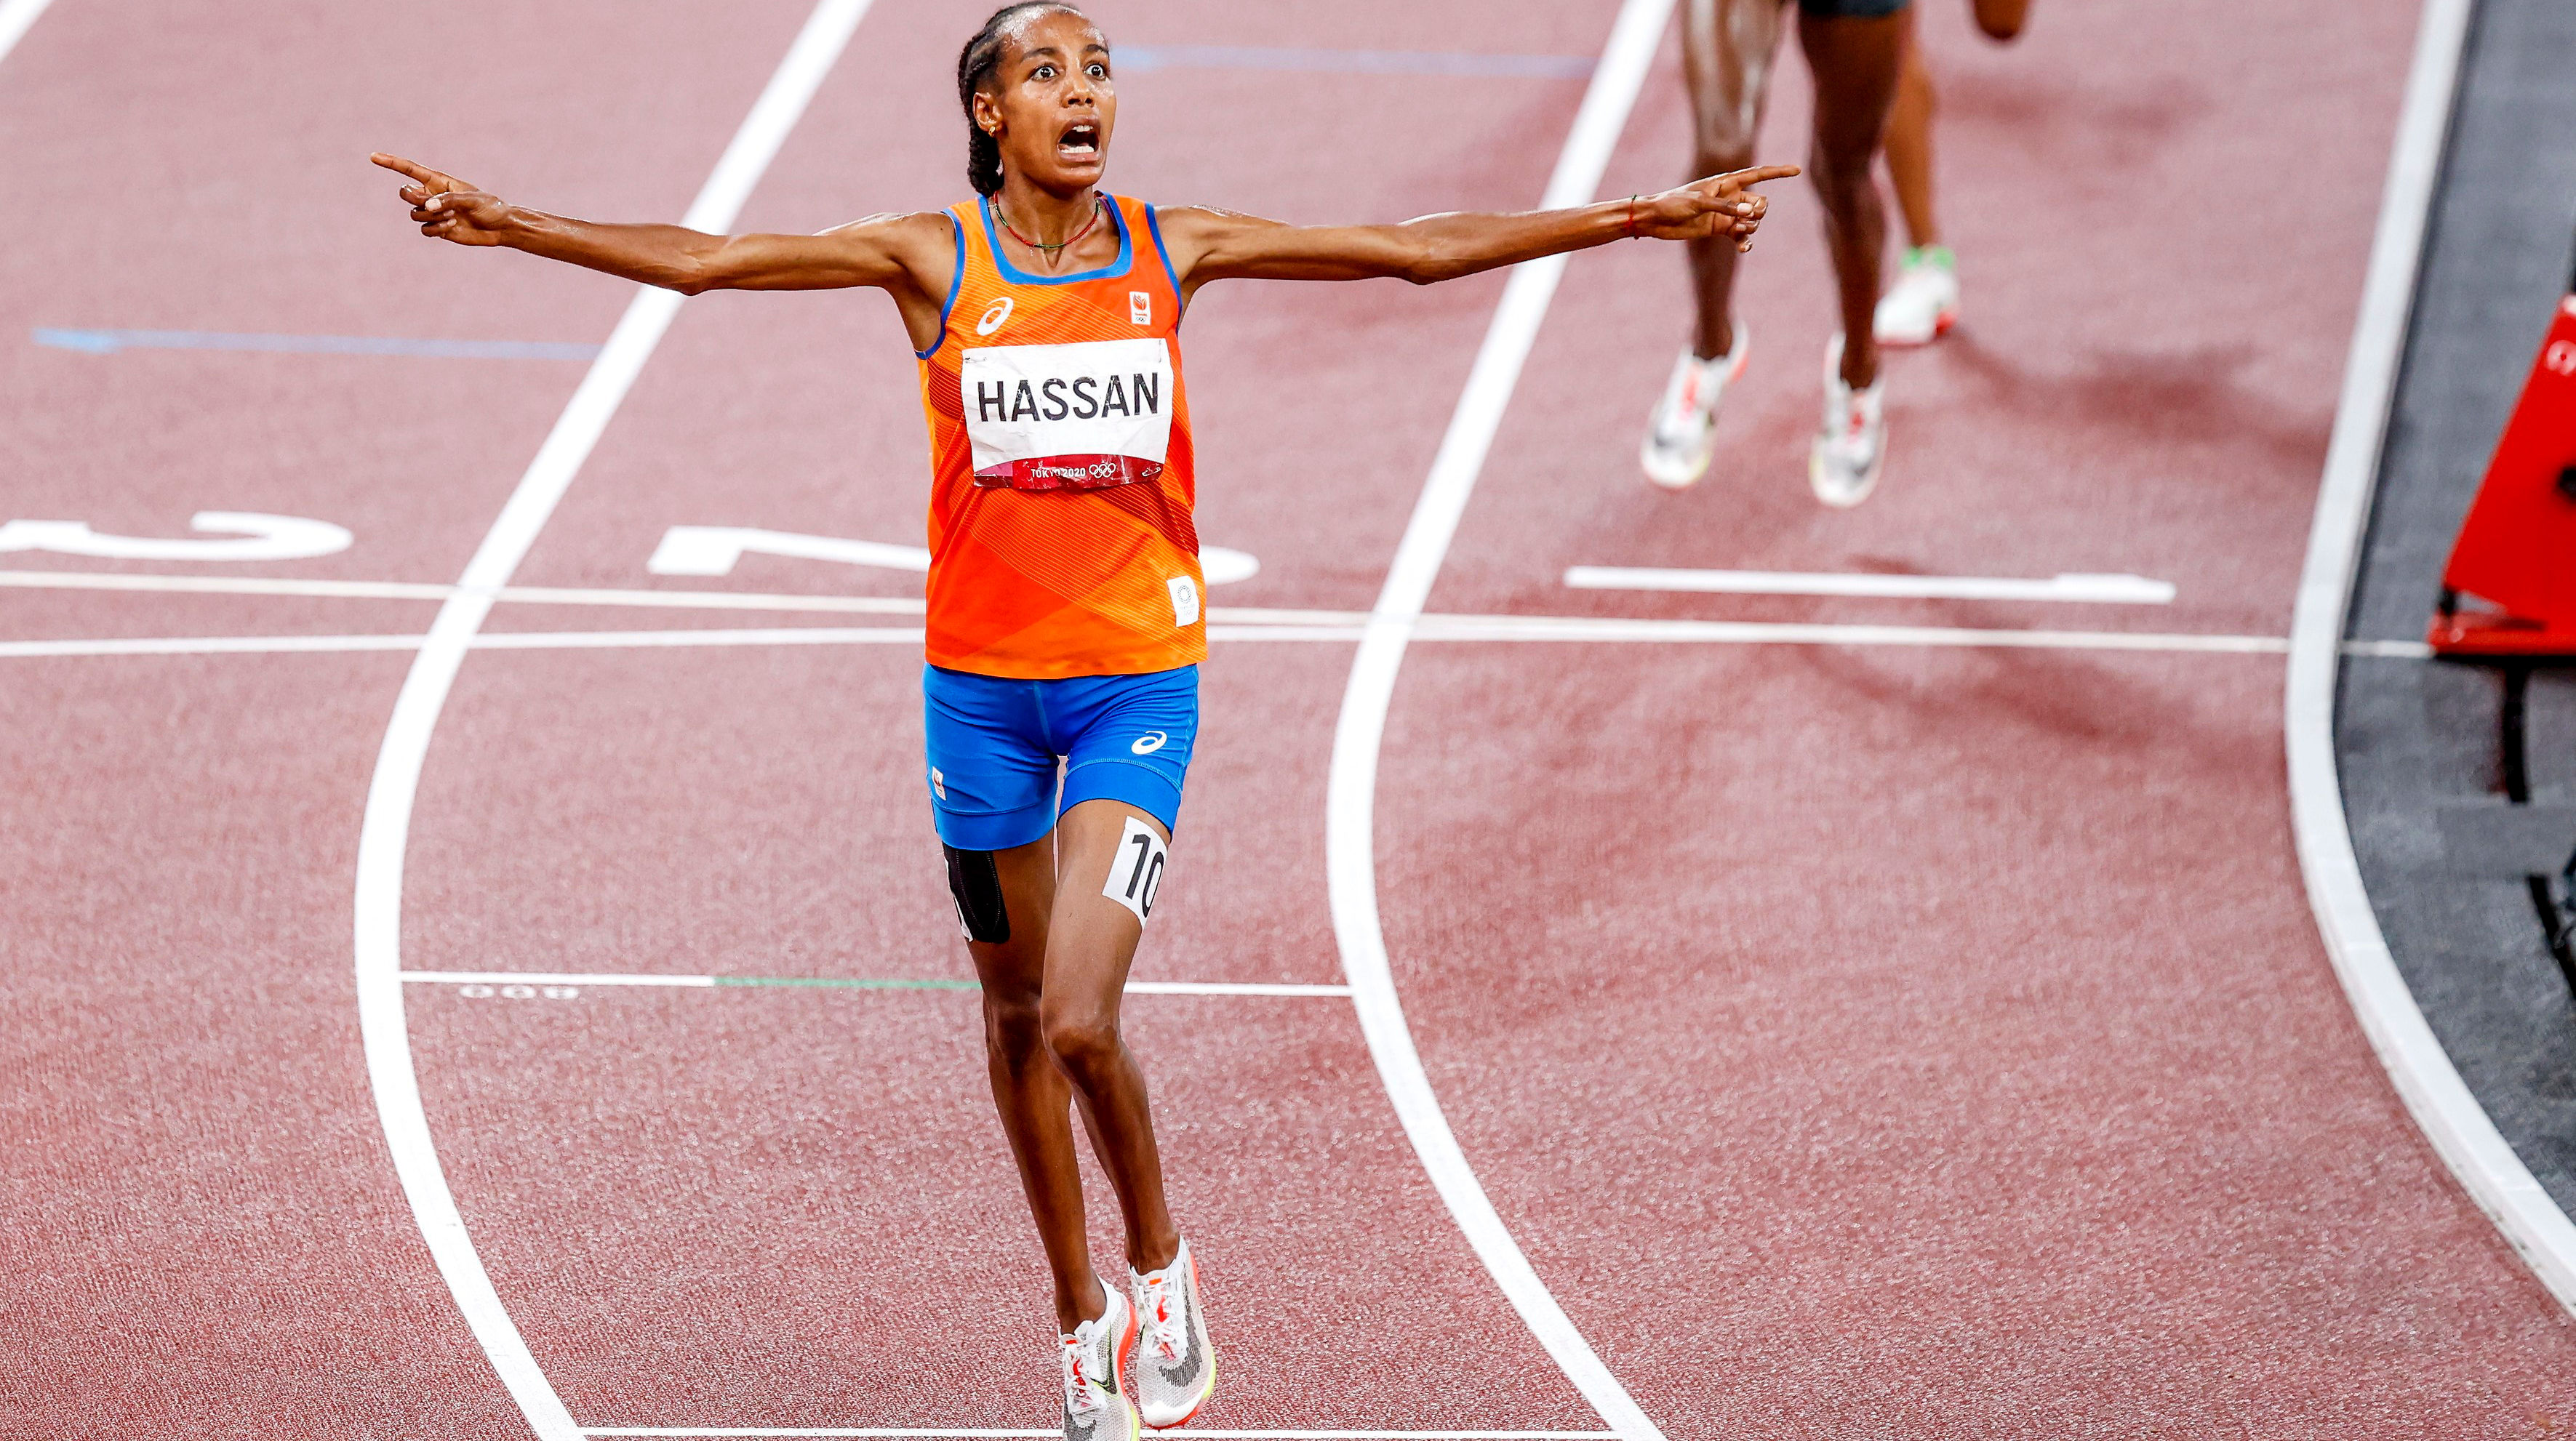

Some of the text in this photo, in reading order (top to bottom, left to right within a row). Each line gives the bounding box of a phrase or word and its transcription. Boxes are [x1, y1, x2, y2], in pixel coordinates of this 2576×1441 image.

[977, 372, 1159, 422] HASSAN
[1031, 467, 1086, 478] TOKYO 2020
[1125, 832, 1164, 919] 10
